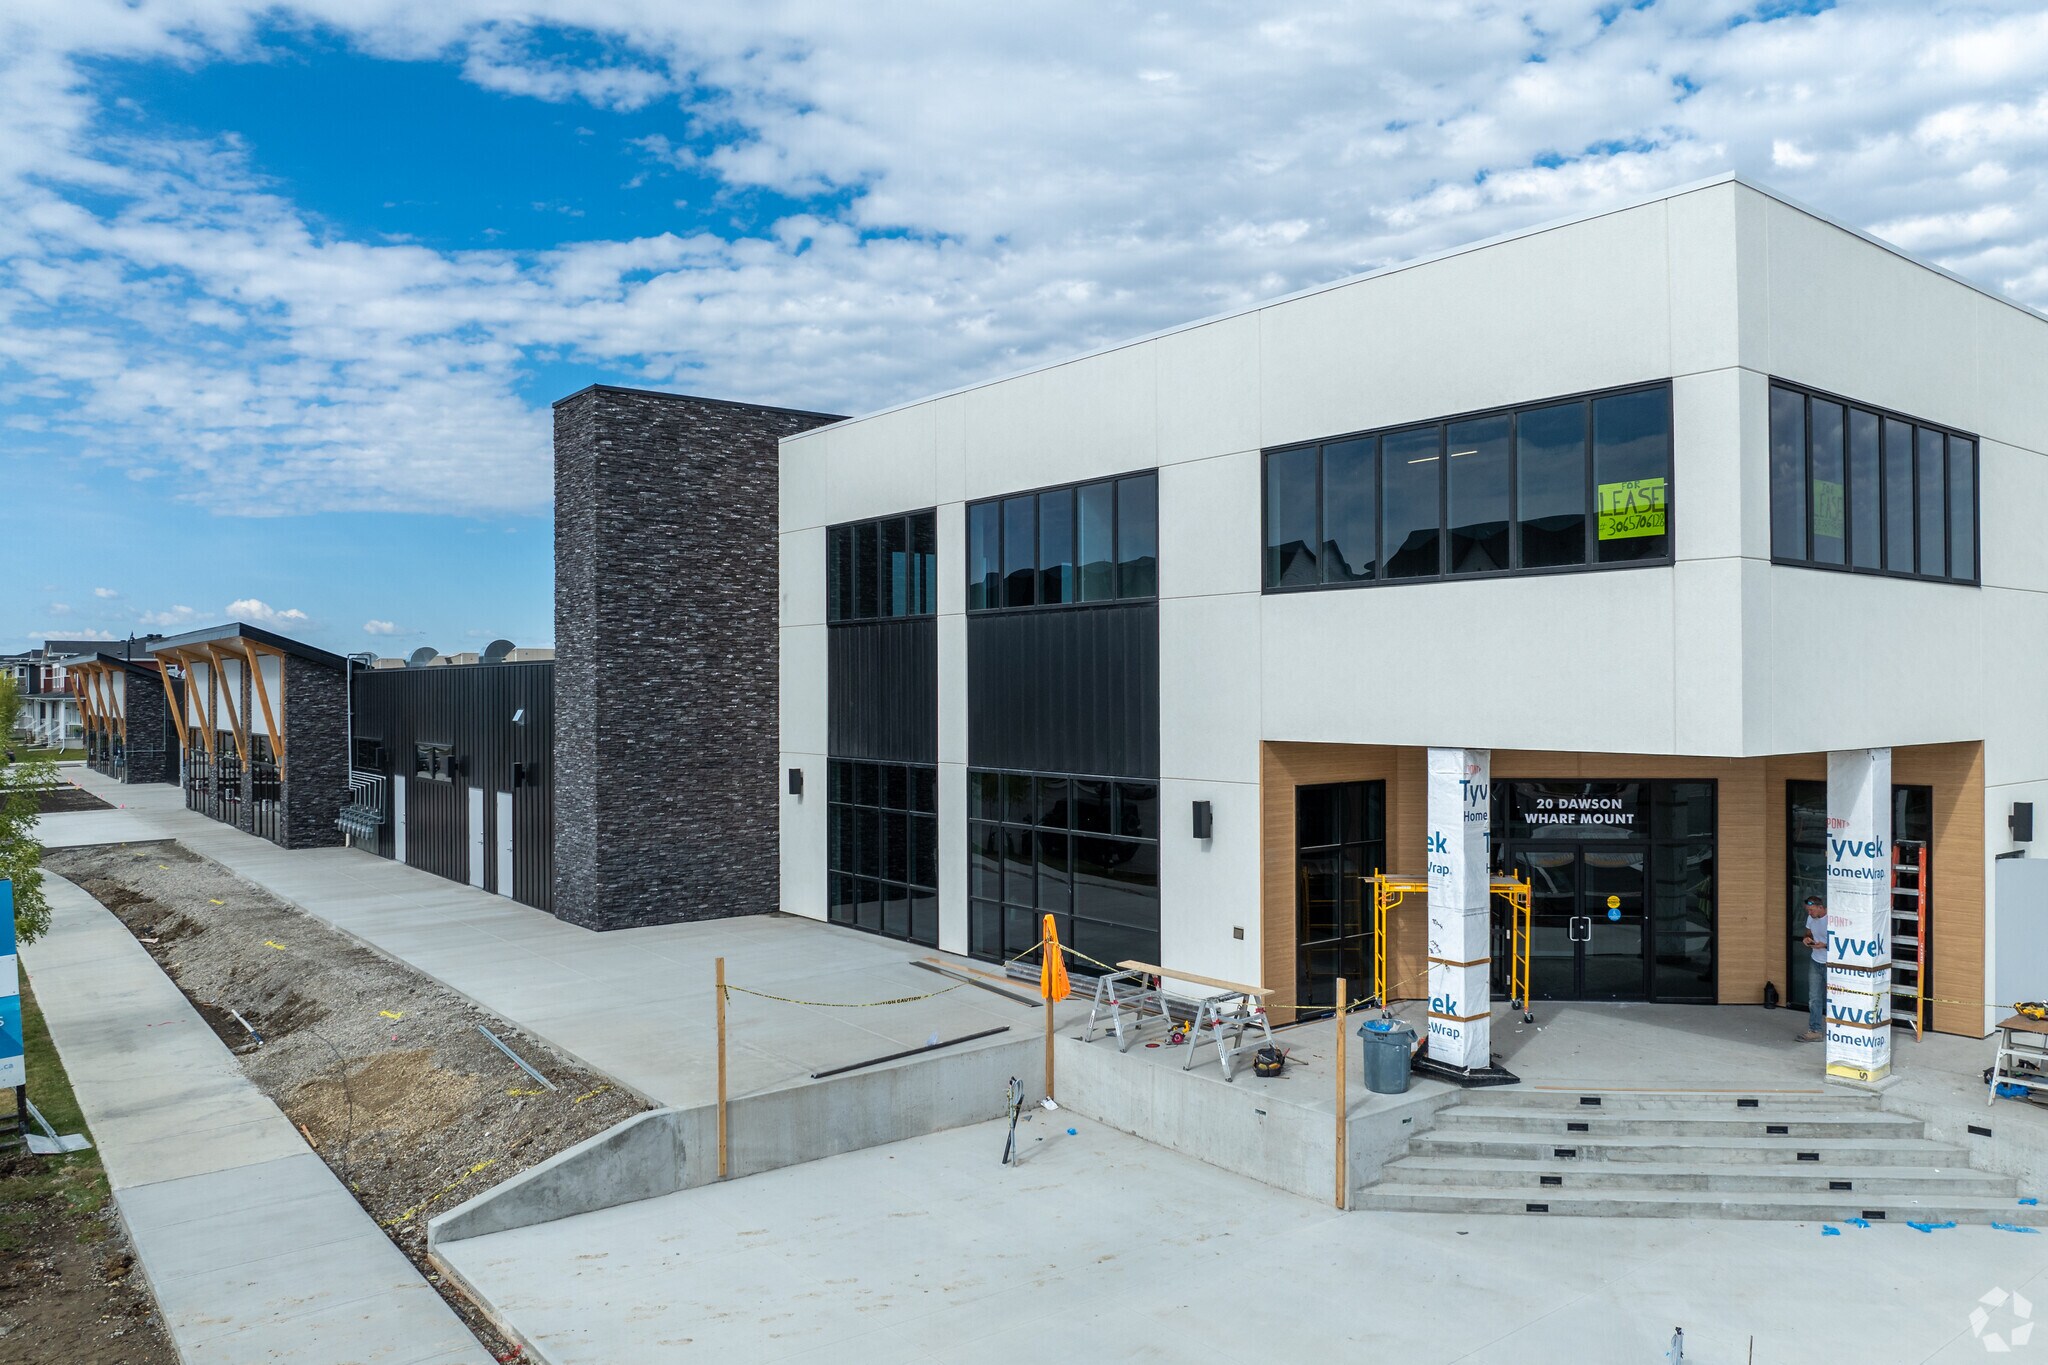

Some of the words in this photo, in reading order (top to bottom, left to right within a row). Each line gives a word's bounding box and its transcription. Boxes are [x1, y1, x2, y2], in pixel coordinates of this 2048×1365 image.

[1621, 480, 1640, 490] FOR
[1599, 486, 1665, 517] LEASE
[1536, 798, 1554, 809] 20
[1558, 798, 1622, 809] DAWSON
[1524, 813, 1576, 824] WHARF
[1580, 813, 1634, 824] MOUNT
[896, 996, 921, 1004] CAUTION
[1428, 993, 1457, 1016] ek
